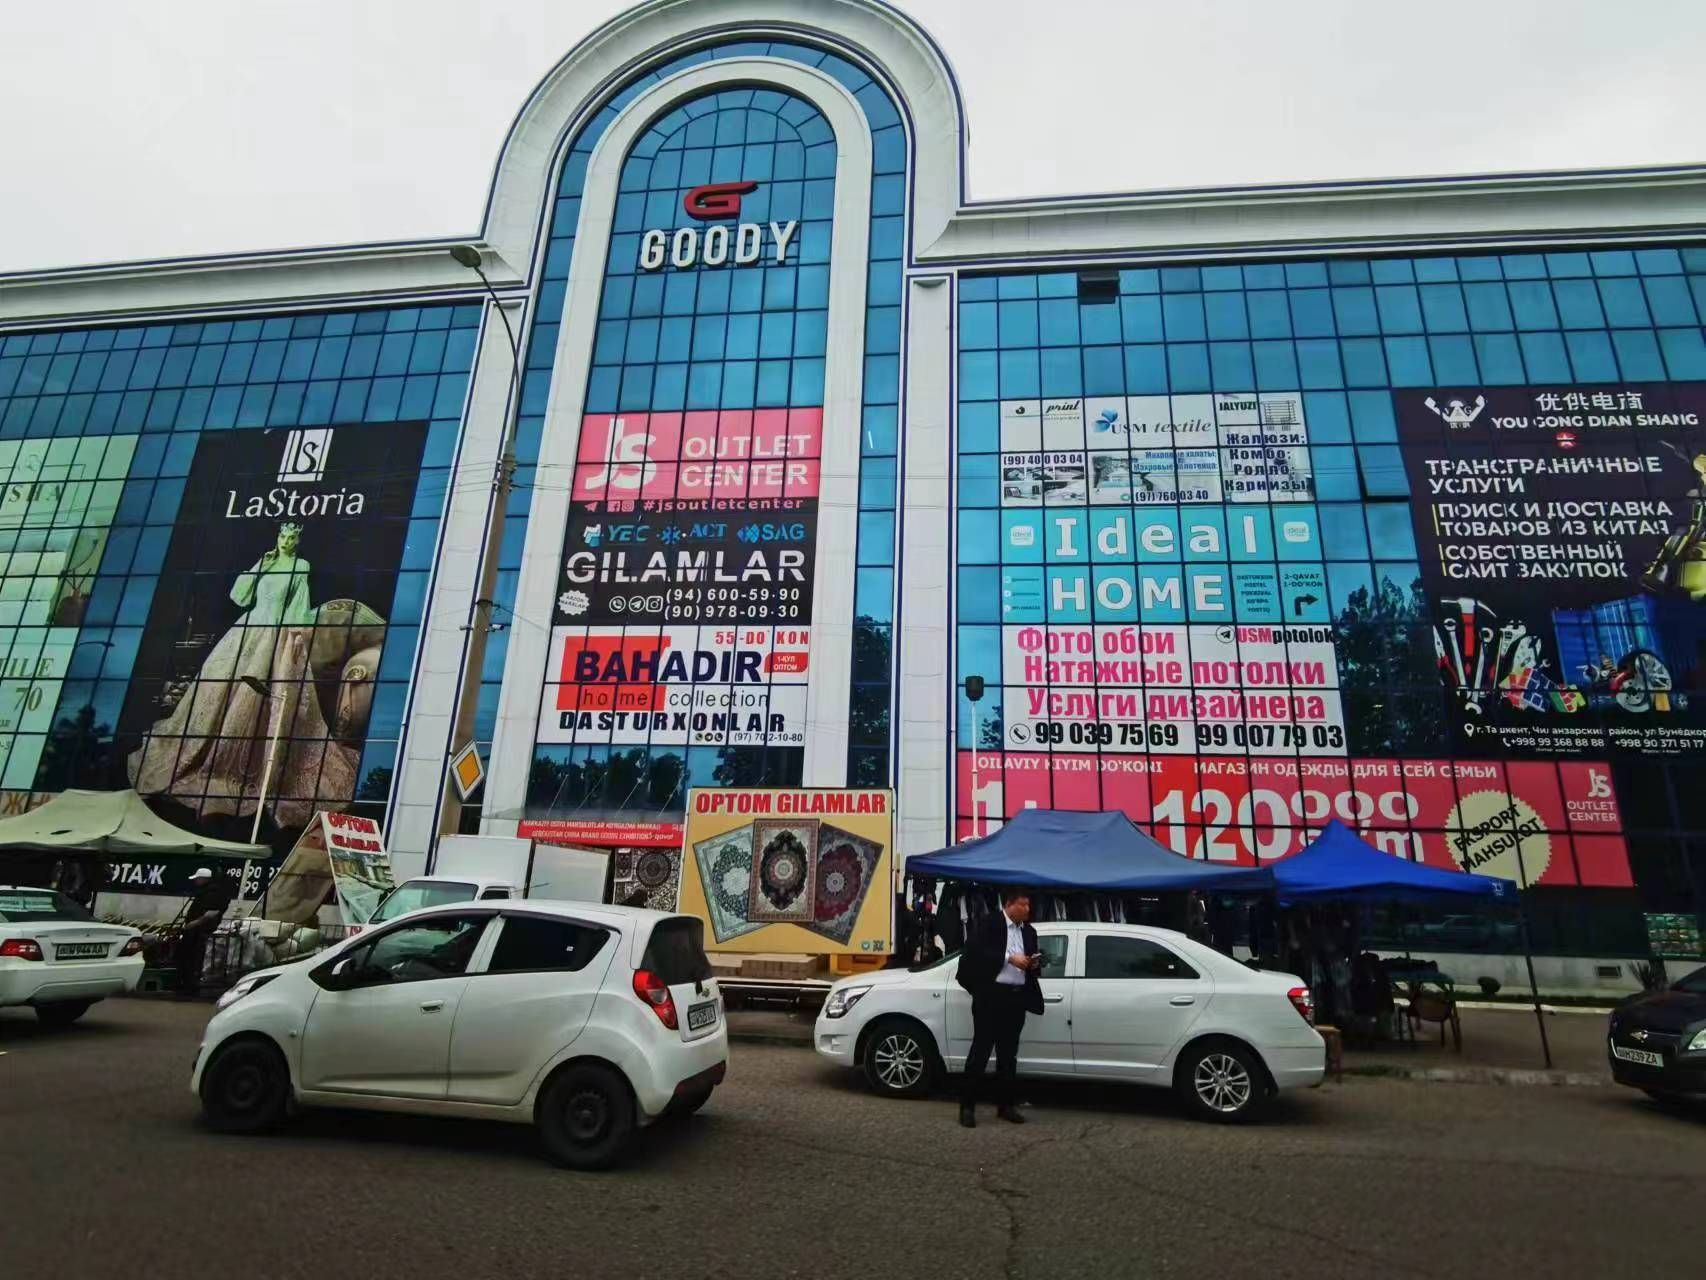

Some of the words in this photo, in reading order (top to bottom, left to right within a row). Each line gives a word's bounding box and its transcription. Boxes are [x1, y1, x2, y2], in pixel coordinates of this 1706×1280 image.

[640, 220, 798, 270] GOODY
[1111, 423, 1147, 434] USM
[1153, 419, 1212, 433] textile
[1491, 416, 1529, 429] YOU
[1533, 415, 1584, 428] GONG
[1588, 415, 1632, 427] DIAN
[1636, 413, 1699, 426] SHANG
[685, 435, 812, 458] OUTLET
[1003, 455, 1025, 465] (99)
[1053, 454, 1067, 464] 03
[1069, 454, 1083, 463] 04
[1425, 457, 1663, 475] ТРАНСГРАНИЧНЫЕ
[681, 464, 809, 488] CENTER
[1428, 477, 1525, 494] УСЛУГИ
[225, 487, 365, 518] LaStoria
[1135, 492, 1155, 502] (97)
[1180, 491, 1193, 500] 03
[1195, 490, 1209, 500] 40
[643, 498, 804, 513] #jsoutletcenter
[1438, 503, 1520, 518] ПОИСК
[1525, 503, 1540, 517] И
[1547, 500, 1674, 519] ДОСТАВКА
[761, 523, 806, 541] SAG
[1055, 514, 1257, 556] Ideal
[1440, 521, 1550, 536] ТОВАРОВ
[1445, 541, 1623, 561] СОБСТВЕННЫЙ
[566, 550, 806, 583] GILAMLAR
[1516, 562, 1628, 579] ЗАКУПОК
[666, 588, 702, 601] (94)
[1051, 574, 1225, 611] HOME
[664, 605, 700, 619] (90)
[1017, 627, 1092, 653] Фото
[1102, 630, 1175, 655] обои
[1237, 627, 1335, 644] USMpotolok
[574, 650, 762, 683] BAHADIR
[1024, 655, 1183, 683] Натяжные
[1192, 661, 1326, 684] потолки
[14, 687, 43, 712] 70
[582, 688, 649, 706] home
[668, 689, 769, 706] collection
[1027, 687, 1137, 719] Услуги
[1148, 689, 1326, 721] дизайнера
[559, 711, 786, 732] DASTURXONLAR
[734, 733, 752, 742] (97)
[754, 733, 803, 742] 702-10-80
[1035, 723, 1063, 745] 99
[1070, 723, 1112, 745] 039
[1117, 723, 1144, 745] 75
[1149, 723, 1179, 746] 69
[1198, 725, 1228, 746] 99
[1233, 724, 1274, 747] 007
[1279, 725, 1307, 747] 79
[1312, 725, 1344, 748] 03
[1511, 737, 1536, 746] +998
[1538, 738, 1551, 746] 99
[1553, 738, 1573, 746] 368
[1575, 738, 1589, 746] 88
[1591, 739, 1604, 747] 88
[1615, 739, 1641, 747] +998
[1643, 739, 1658, 747] 90
[977, 757, 1040, 769] OILAVIY
[1045, 759, 1092, 771] KIYIM
[1194, 761, 1269, 776] МАГАЗИН
[1273, 763, 1349, 779] ОДЕЖДЫ
[1353, 763, 1388, 778] ДЛЯ
[1393, 762, 1435, 777] ВСЕЙ
[1440, 765, 1497, 779] СЕМЬИ
[696, 793, 771, 813] OPTOM
[777, 793, 886, 814] GILAMLAR
[1567, 800, 1616, 811] OUTLET
[1568, 811, 1617, 822] CENTER
[1453, 803, 1521, 852] EKSPORT
[1460, 817, 1543, 872] MAHSULOT
